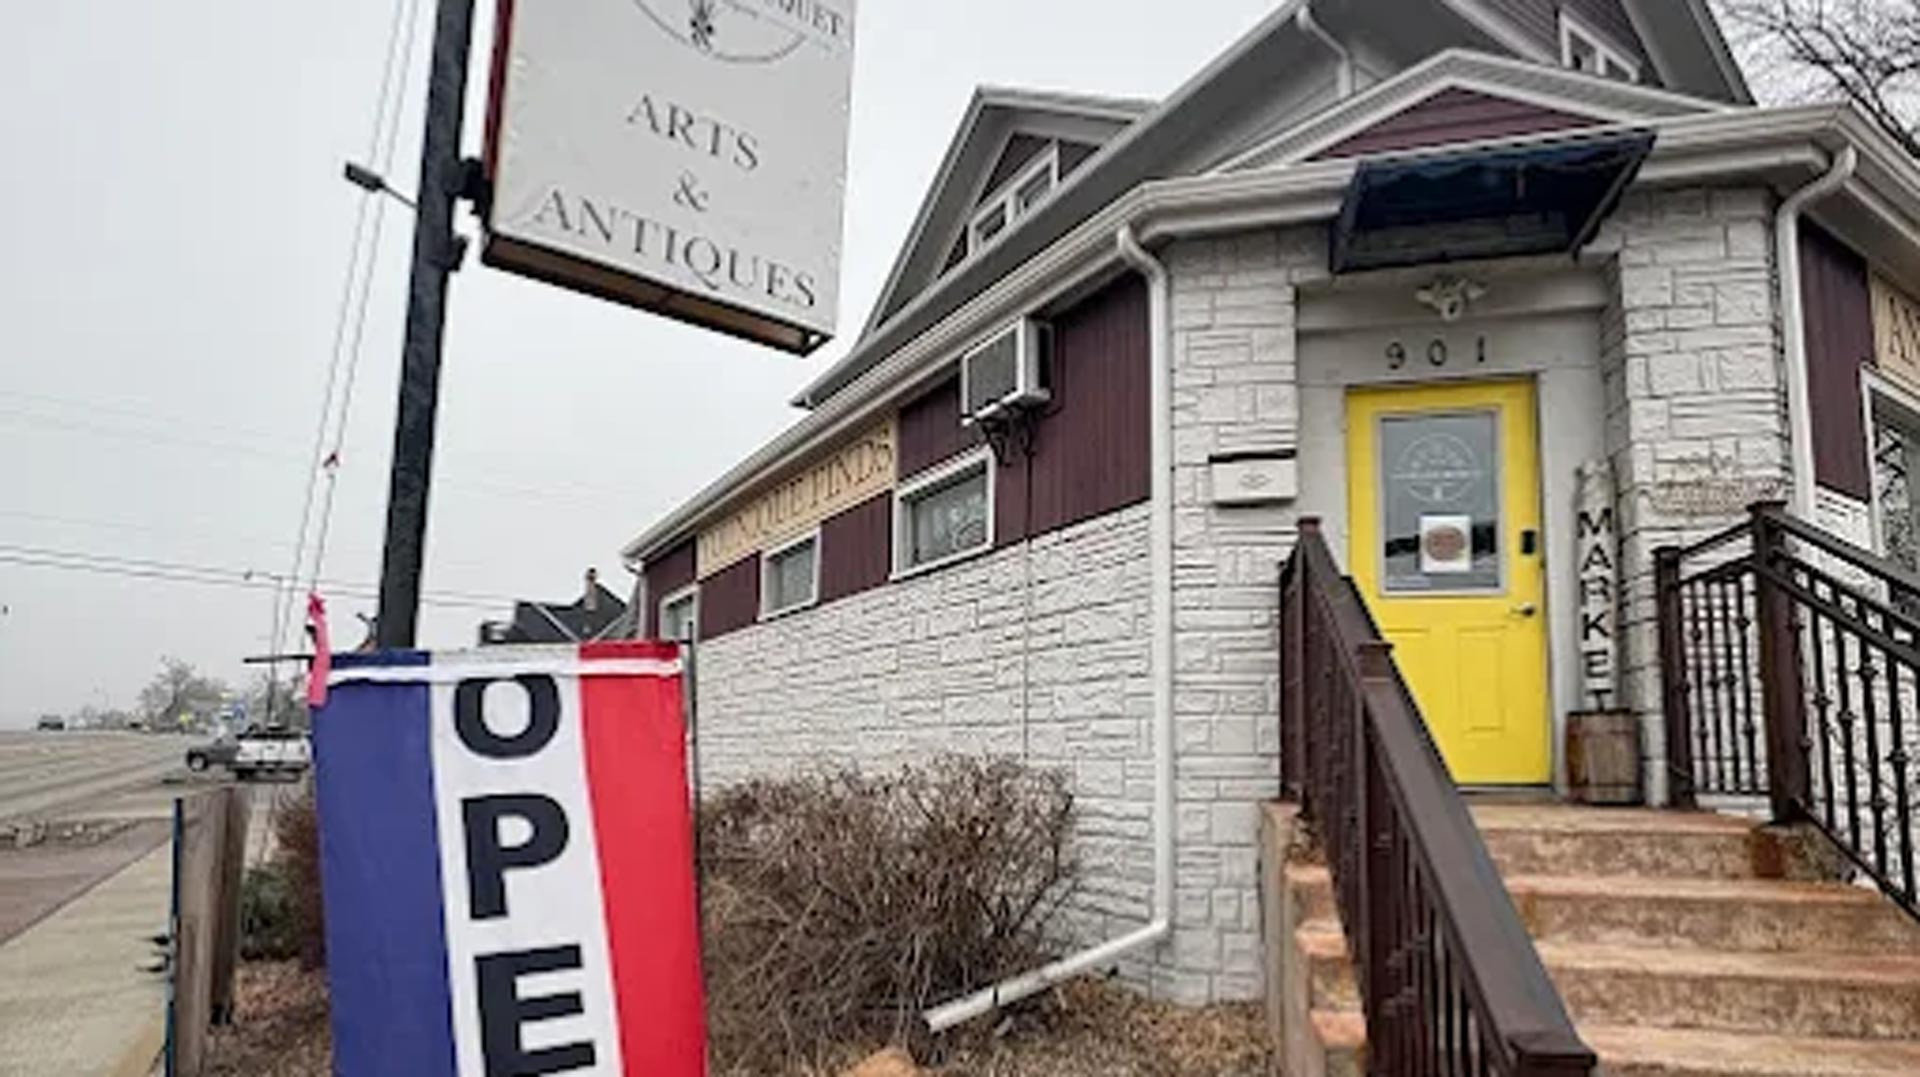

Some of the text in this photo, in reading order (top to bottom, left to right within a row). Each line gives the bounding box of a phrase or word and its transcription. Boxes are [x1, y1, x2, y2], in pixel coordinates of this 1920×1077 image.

[627, 94, 760, 172] ARTS
[673, 169, 709, 213] &
[533, 189, 816, 308] ANTIQUES
[1386, 335, 1486, 370] 901
[1577, 507, 1613, 712] MARKET
[453, 673, 597, 1077] OPE
